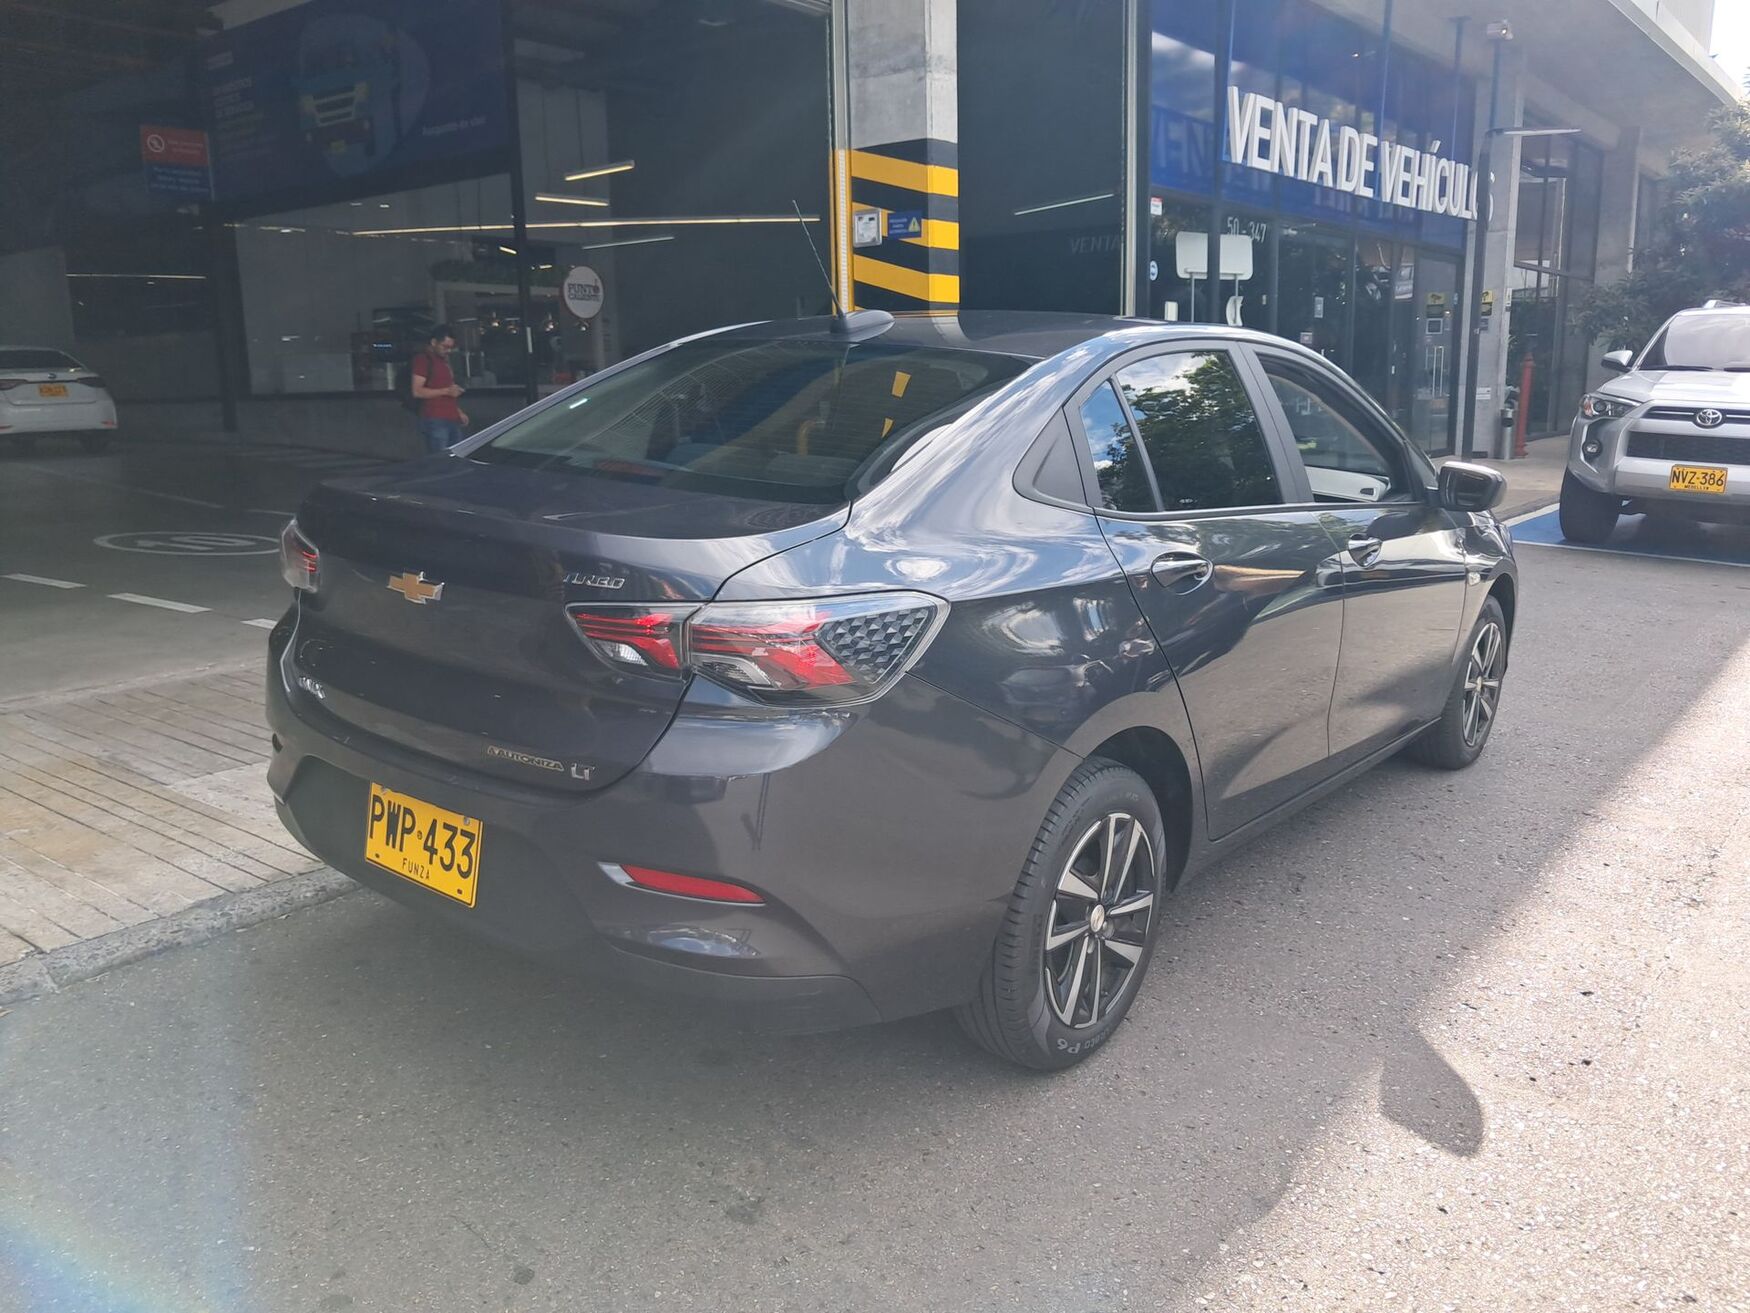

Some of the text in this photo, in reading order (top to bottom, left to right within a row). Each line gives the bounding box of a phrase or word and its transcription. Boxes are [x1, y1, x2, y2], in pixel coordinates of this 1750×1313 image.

[1227, 85, 1333, 188] VENTA
[1336, 125, 1379, 198] DE
[1249, 221, 1267, 243] 347
[569, 761, 596, 782] LT
[401, 857, 431, 881] FUNZA
